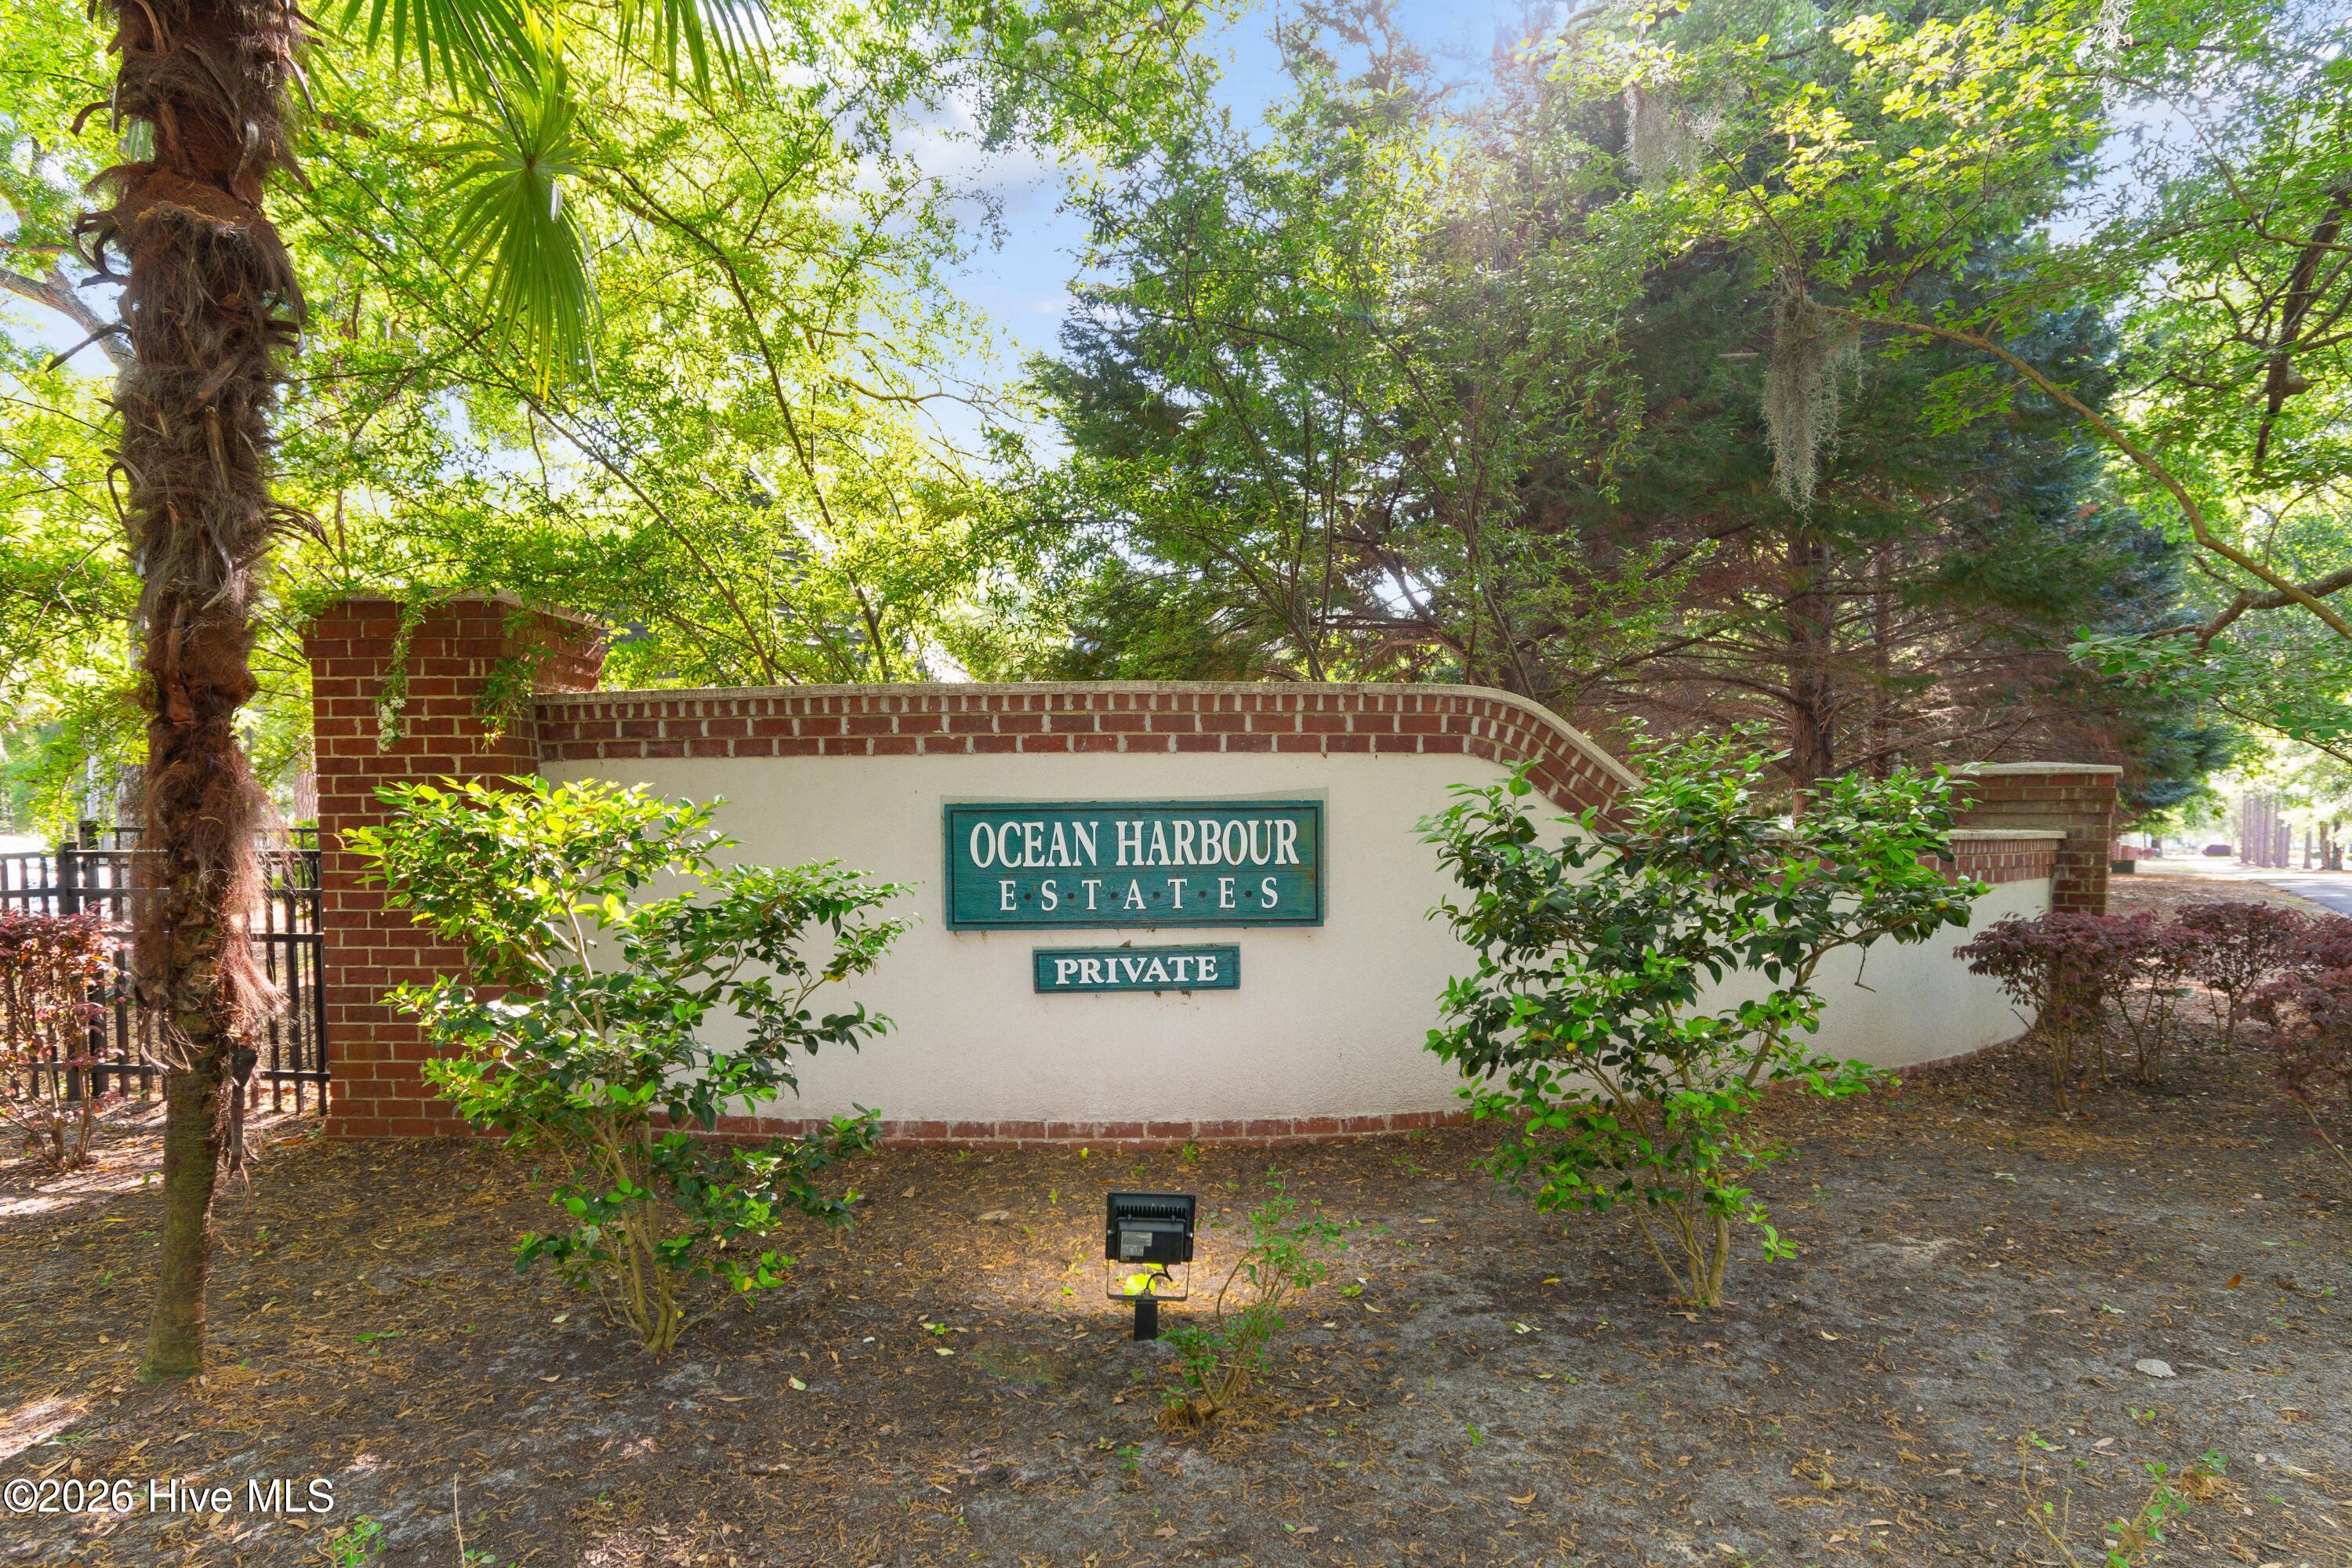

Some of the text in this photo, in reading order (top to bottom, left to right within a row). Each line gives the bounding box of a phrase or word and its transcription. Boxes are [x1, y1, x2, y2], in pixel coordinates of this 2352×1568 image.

[970, 820, 1300, 868] OCEAN HARBOUR
[1054, 956, 1218, 985] PRIVATE
